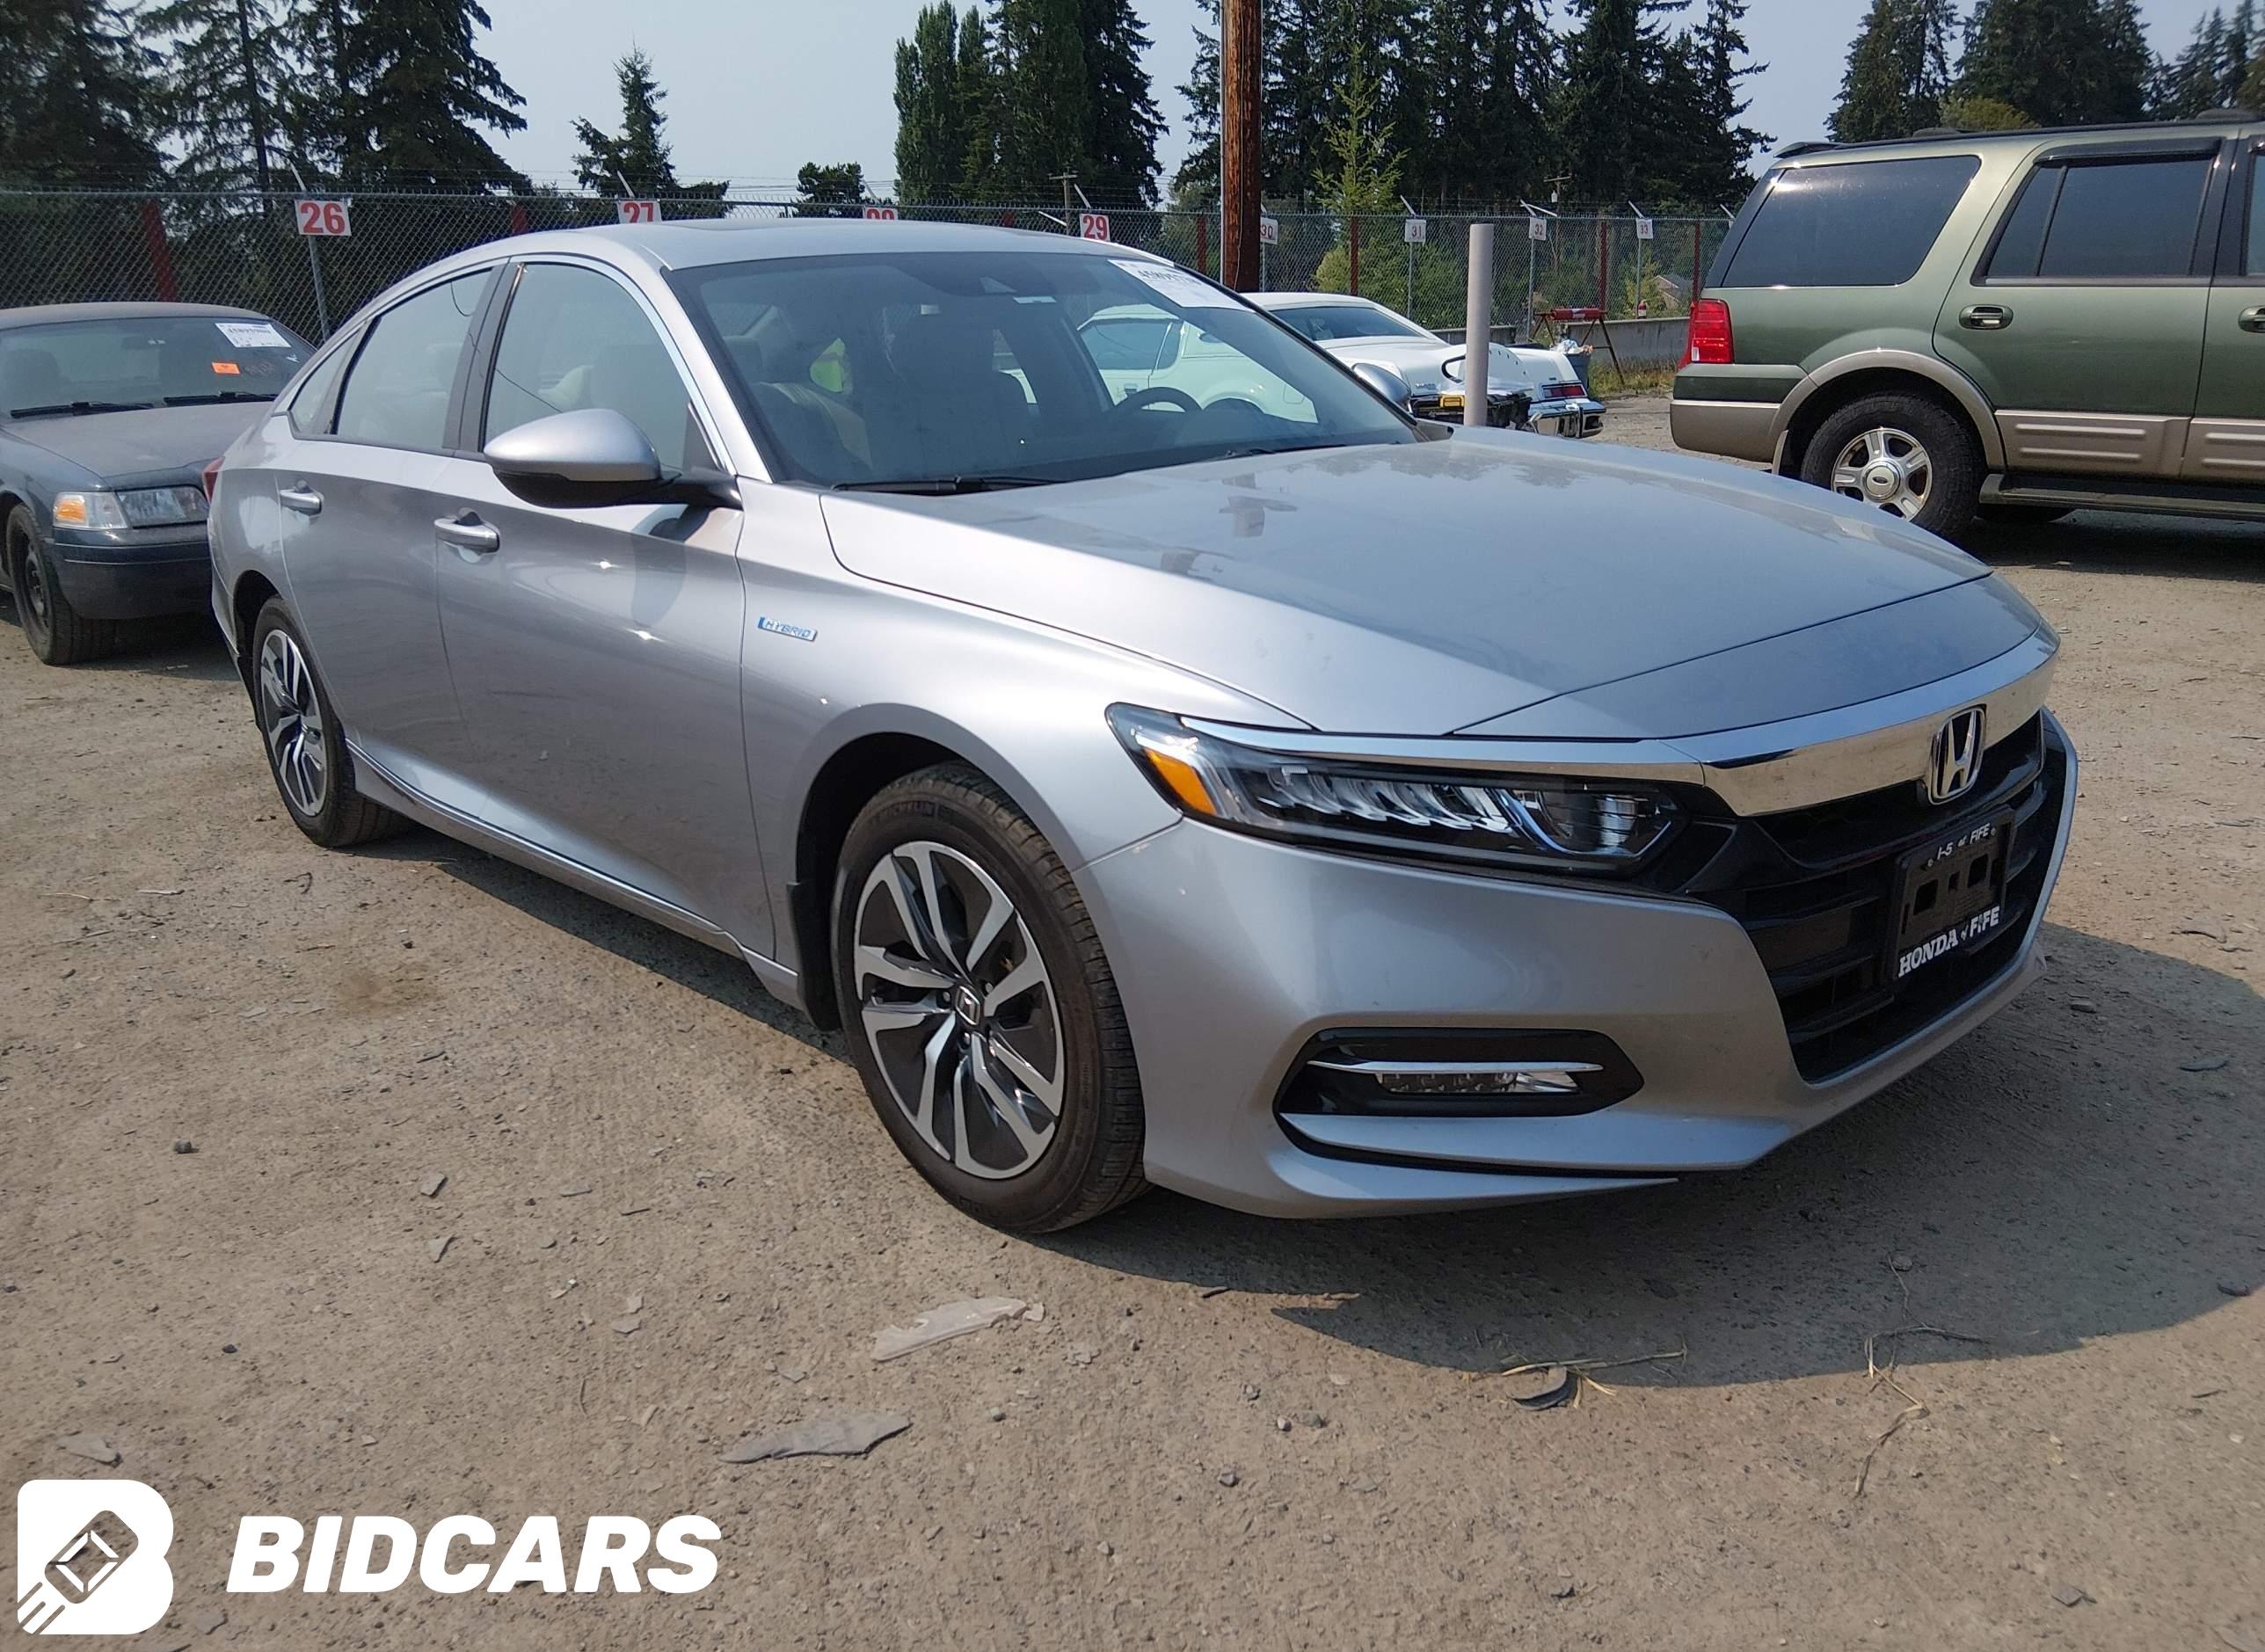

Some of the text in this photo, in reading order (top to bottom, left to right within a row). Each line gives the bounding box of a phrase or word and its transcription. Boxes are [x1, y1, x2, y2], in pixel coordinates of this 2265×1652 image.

[301, 202, 346, 235] 26
[623, 202, 654, 223] 27
[1083, 215, 1108, 241] 29
[1261, 224, 1273, 238] 30
[1412, 224, 1422, 237] 31
[1534, 223, 1543, 235] 32
[765, 620, 812, 637] HYBRID
[1970, 822, 1991, 845] FIFE
[1898, 928, 1959, 979] HONDA
[1970, 905, 2000, 938] FIFE
